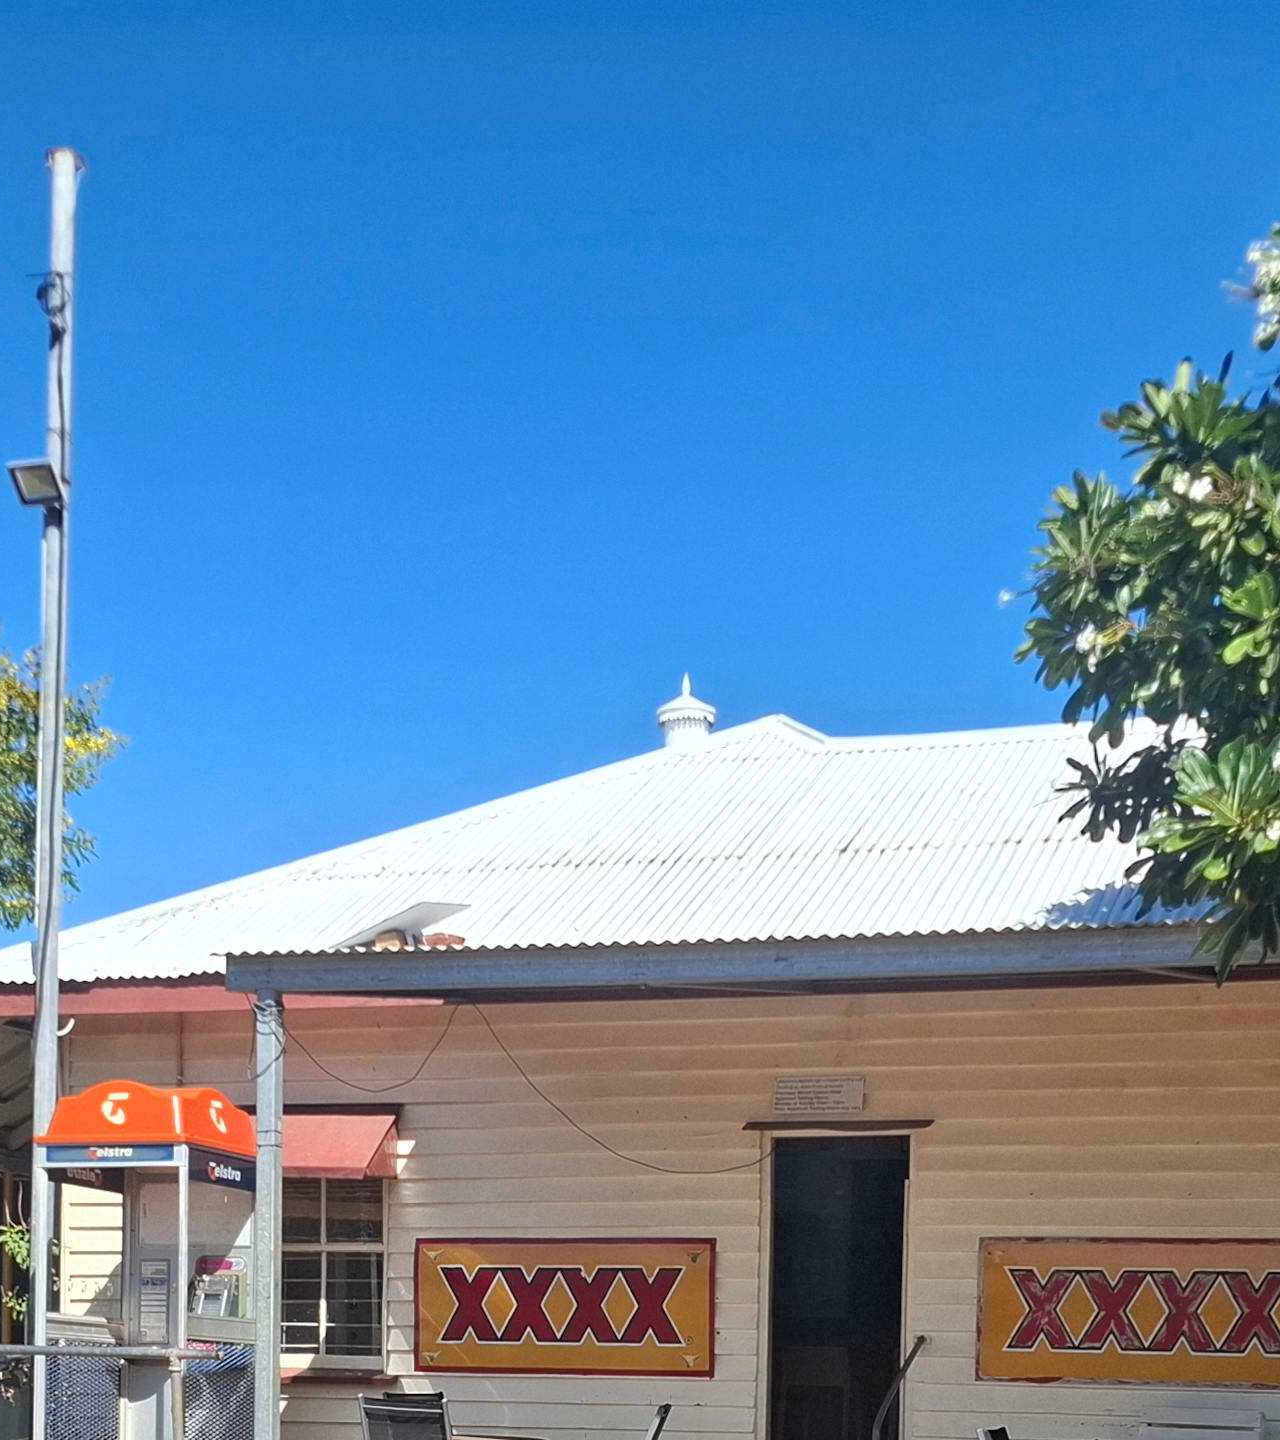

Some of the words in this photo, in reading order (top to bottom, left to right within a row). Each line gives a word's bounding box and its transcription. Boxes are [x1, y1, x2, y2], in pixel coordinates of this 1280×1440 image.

[87, 1147, 133, 1160] Telstra
[208, 1162, 241, 1182] Telstra
[436, 1265, 686, 1347] XXXX
